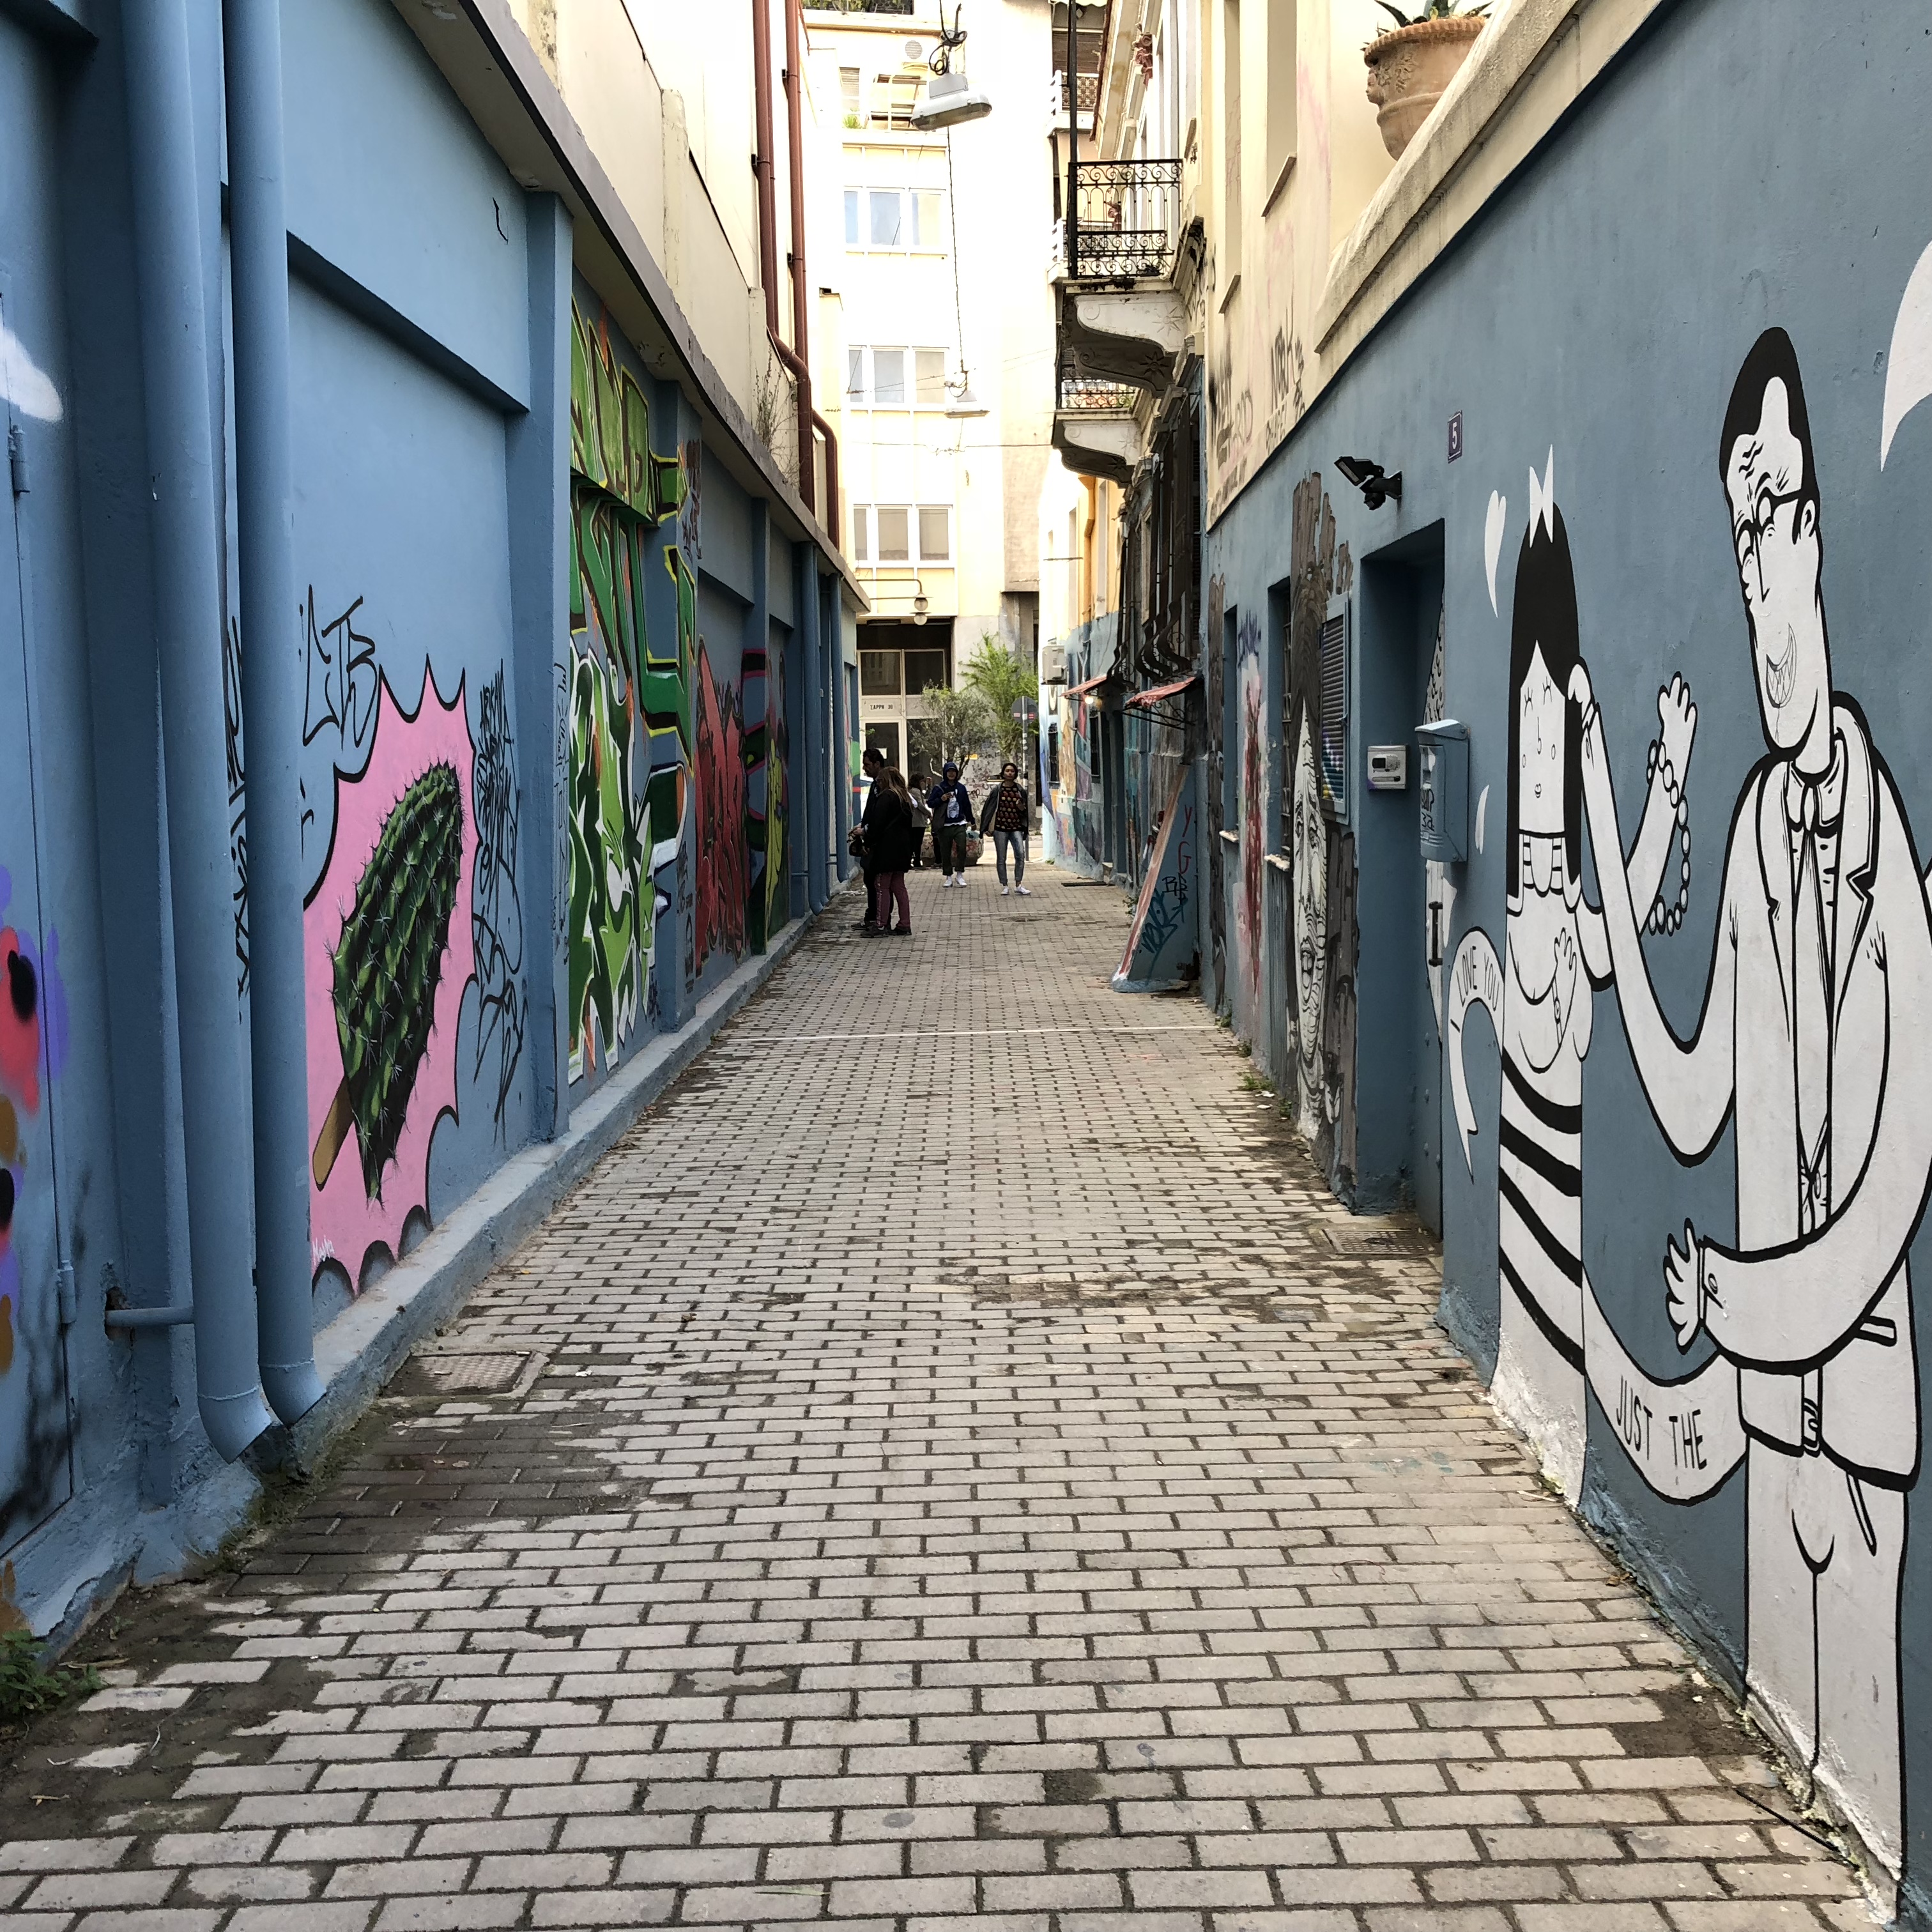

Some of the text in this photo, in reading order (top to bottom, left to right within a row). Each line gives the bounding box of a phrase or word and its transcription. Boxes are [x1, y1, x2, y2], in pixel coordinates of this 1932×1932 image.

[1452, 421, 1457, 450] 5
[1456, 945, 1499, 1012] LOVE YOU
[1616, 1375, 1707, 1471] JUST THE
